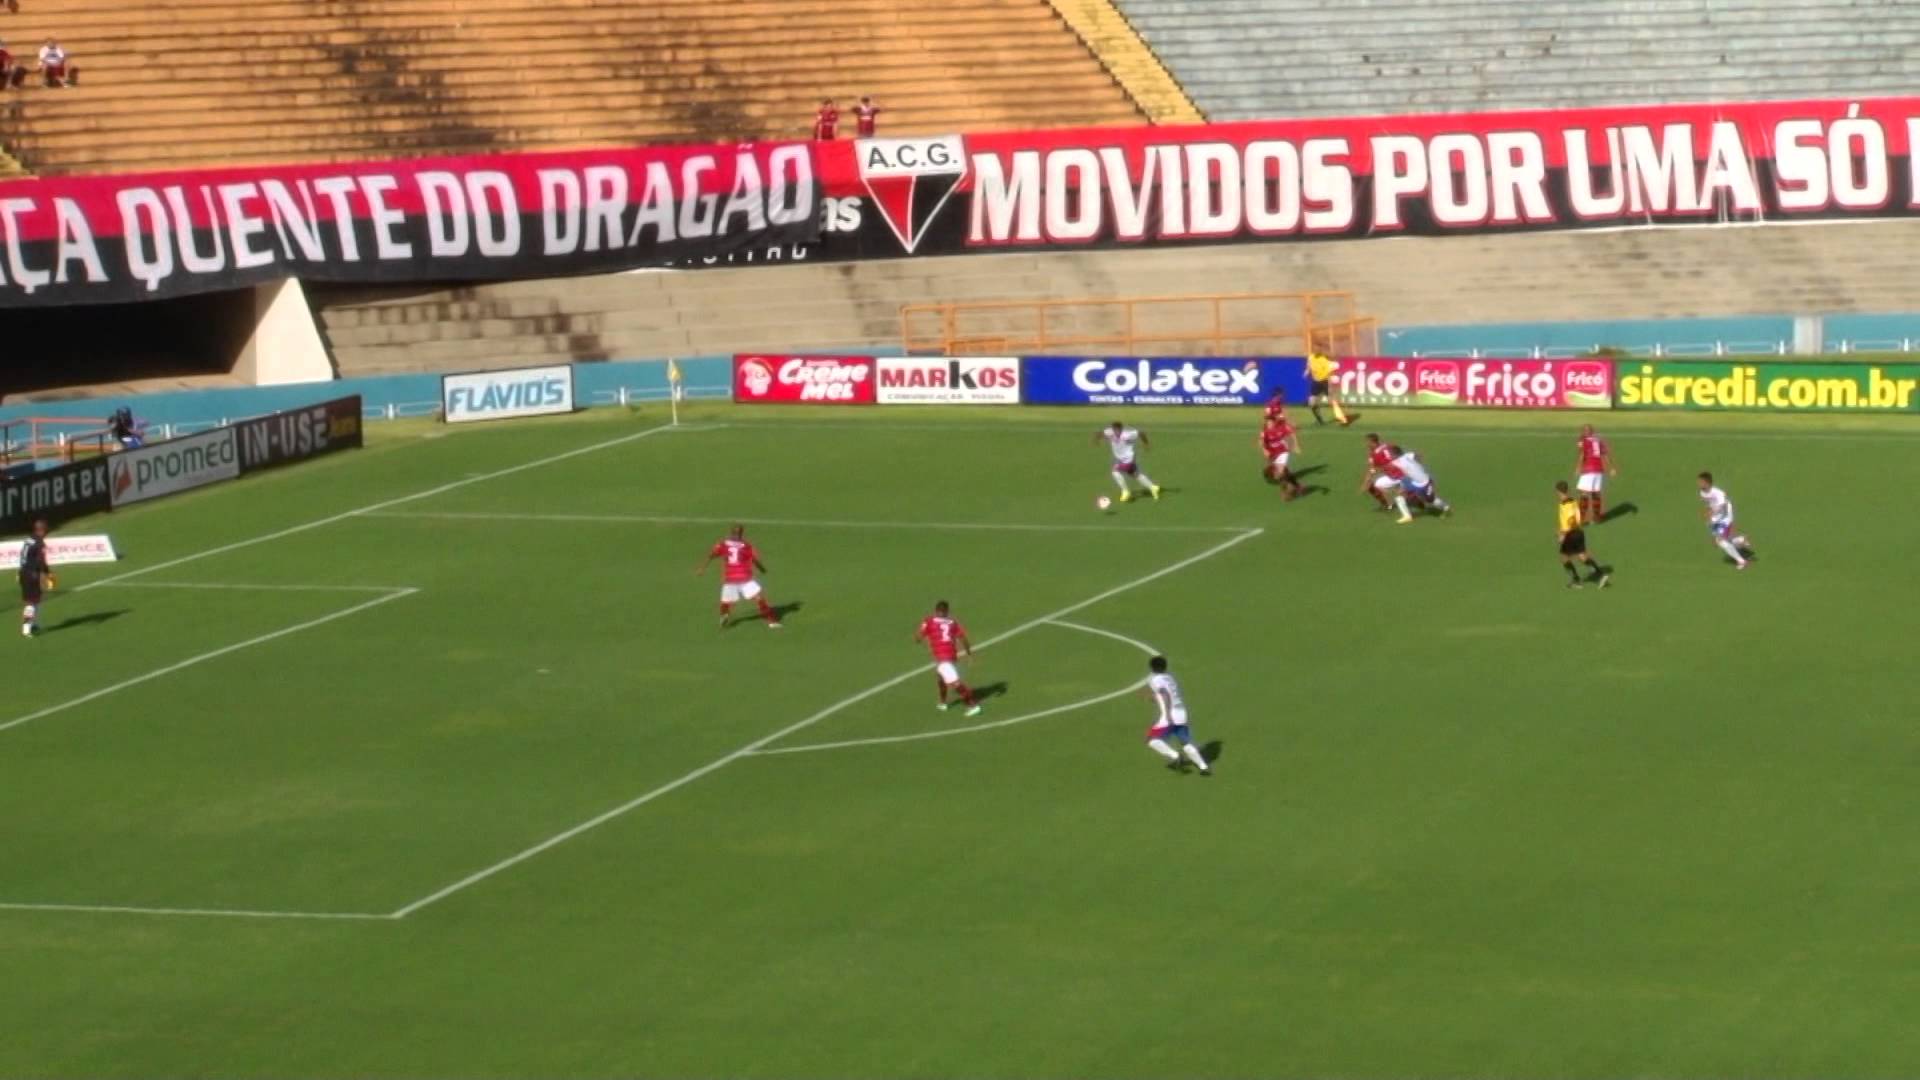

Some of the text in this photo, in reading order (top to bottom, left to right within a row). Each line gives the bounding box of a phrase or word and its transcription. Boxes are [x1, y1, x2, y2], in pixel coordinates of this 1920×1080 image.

[868, 143, 957, 169] A.C.G.
[969, 139, 1354, 243] MOVIDOS
[1370, 130, 1553, 230] POR
[1563, 121, 1761, 217] UMA
[1776, 103, 1889, 207] SÓ
[0, 143, 814, 293] ÇA QUENTE DO DRAGÃO
[1073, 359, 1259, 393] Colatex
[1466, 362, 1556, 397] Fricó
[1620, 365, 1916, 408] sicredi.com.br
[136, 437, 235, 491] promed
